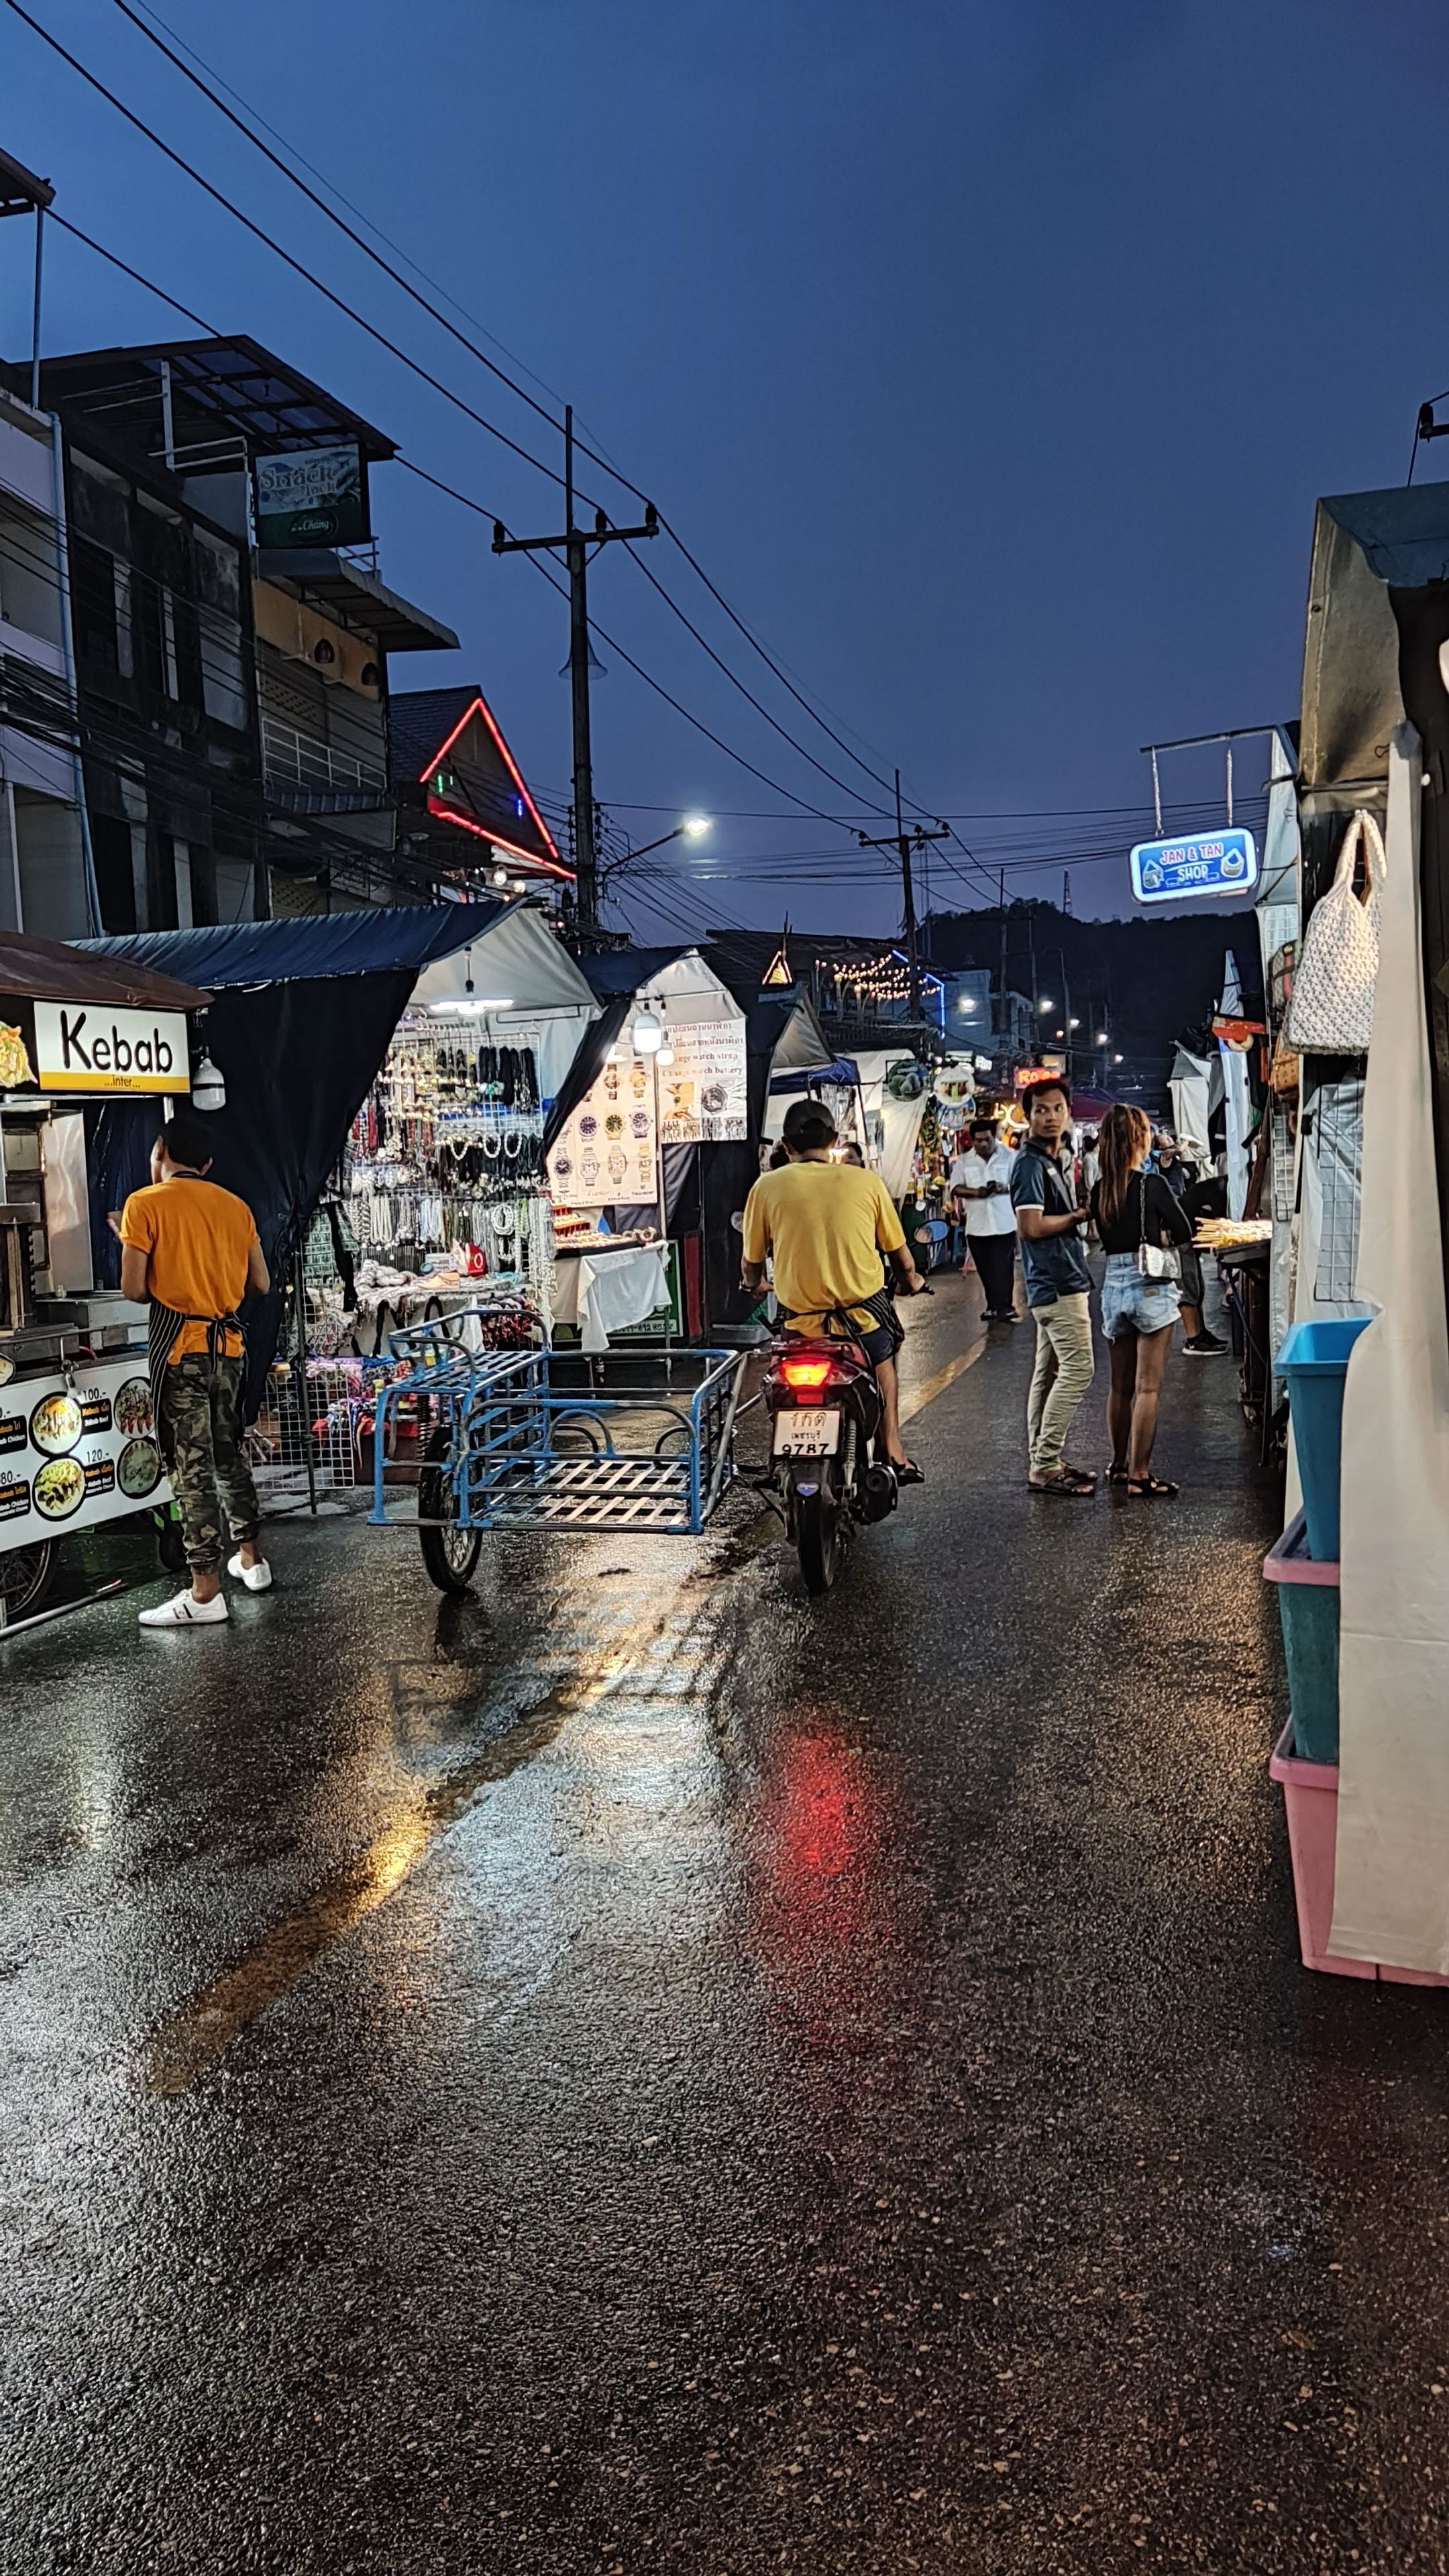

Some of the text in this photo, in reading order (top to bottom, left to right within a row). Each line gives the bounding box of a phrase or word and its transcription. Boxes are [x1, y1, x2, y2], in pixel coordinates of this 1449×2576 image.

[303, 519, 329, 531] Chang
[1161, 843, 1222, 863] JAN & TAN
[1177, 865, 1208, 881] SHOP
[60, 1010, 173, 1073] Kebab
[717, 1053, 739, 1061] strap
[83, 1388, 106, 1401] 100.-
[87, 1448, 109, 1462] 120.-
[782, 1443, 829, 1455] 9787
